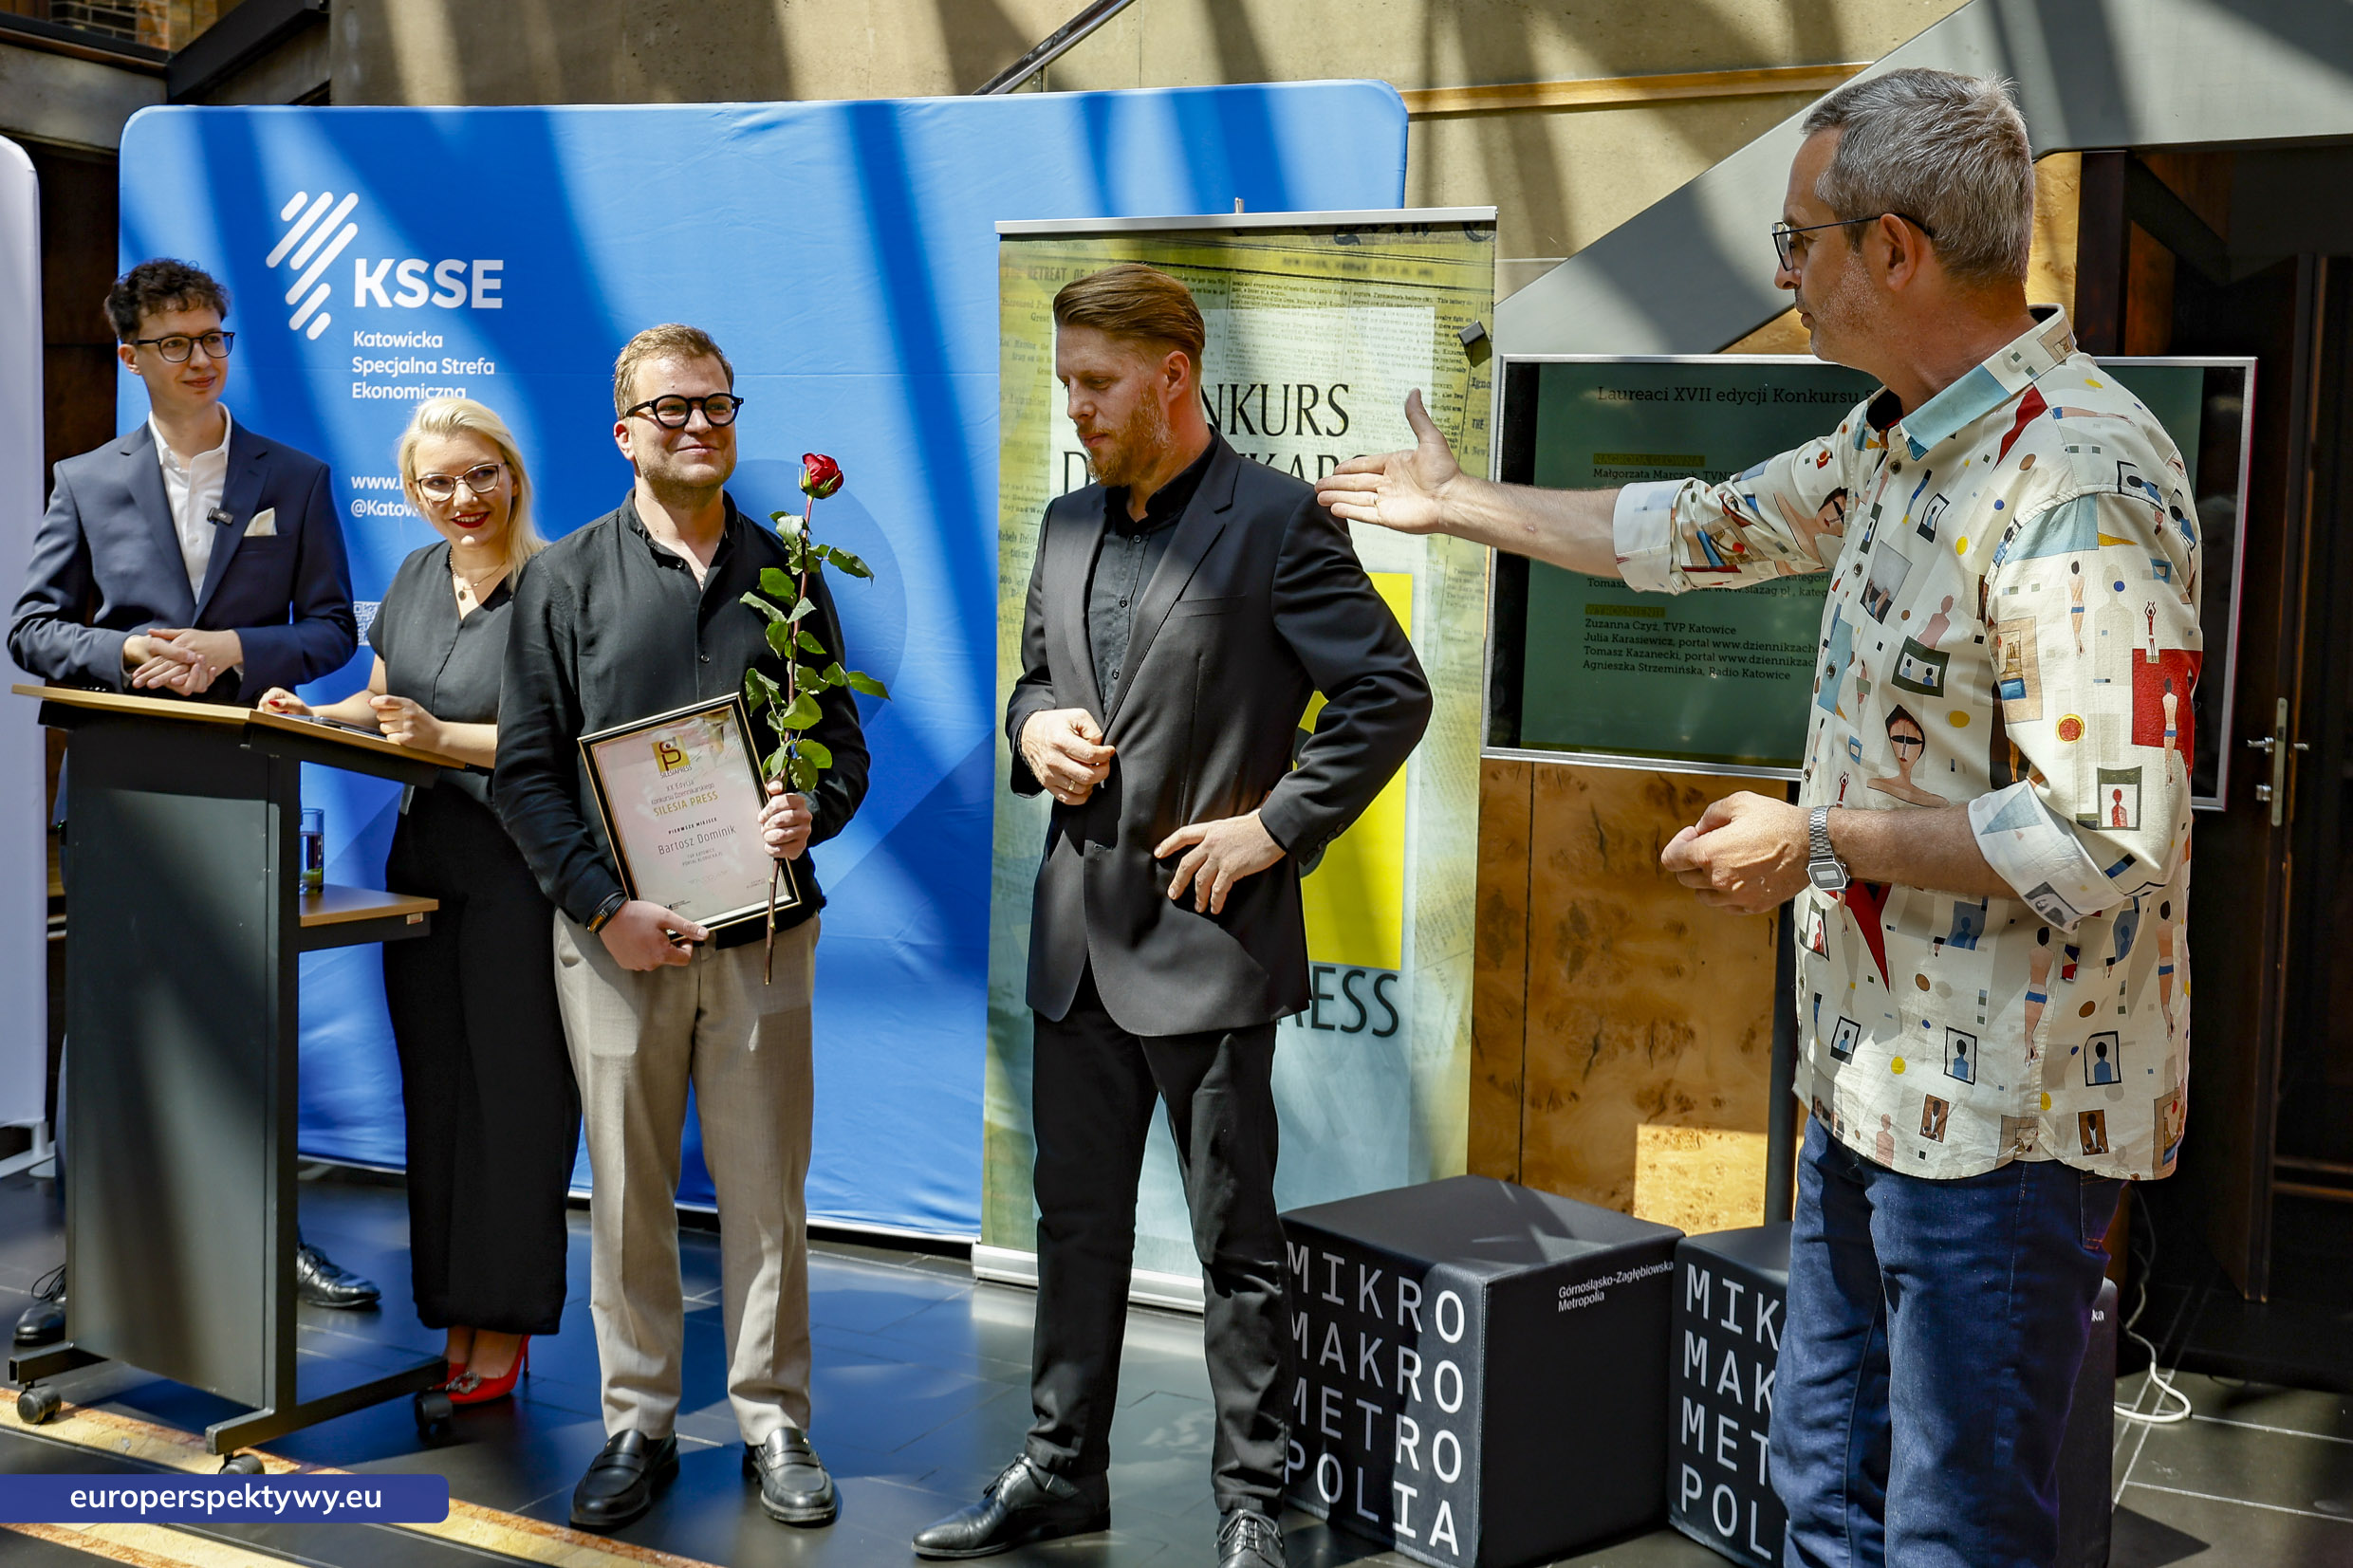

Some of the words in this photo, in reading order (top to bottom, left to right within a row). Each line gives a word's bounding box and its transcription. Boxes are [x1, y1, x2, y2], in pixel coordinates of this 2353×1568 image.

[353, 257, 504, 309] KSSE
[353, 330, 443, 349] Katowicka
[351, 356, 437, 378] Specjalna
[441, 357, 495, 376] Strefa
[351, 381, 468, 400] Ekonomiczna
[1597, 386, 1669, 402] Laureaci
[1673, 387, 1712, 403] XVII
[1715, 387, 1767, 407] edycji
[1772, 388, 1859, 405] Konkursu
[1200, 383, 1349, 437] NKURS
[1593, 468, 1650, 480] Małgorzata
[1587, 578, 1627, 588] Tomasz
[1799, 586, 1827, 600] kateg
[1584, 618, 1630, 630] Zuzanna
[1663, 622, 1686, 633] TVP
[1688, 624, 1736, 636] Katowice
[1584, 632, 1609, 643] Julia
[1611, 634, 1676, 647] Karasiewicz,
[1678, 637, 1710, 649] portal
[1584, 645, 1623, 657] Tomasz
[1626, 647, 1681, 660] Kazanecki,
[1684, 650, 1715, 662] portal
[1583, 659, 1636, 672] Agnieszka
[1638, 662, 1705, 676] Strzemińska,
[1709, 666, 1739, 677] Radio
[1742, 669, 1791, 680] Katowice
[653, 799, 688, 817] SILESIA
[690, 790, 719, 807] PRESS
[658, 837, 695, 856] Bartosz
[696, 824, 737, 844] Dominik
[1286, 1241, 1465, 1345] MIKRO
[1558, 1260, 1675, 1299] Górnośląsko-Zagłębiowska
[1558, 1289, 1605, 1313] Metropolia
[1686, 1262, 1781, 1352] MIK
[1290, 1310, 1464, 1414] MAKRO
[1683, 1329, 1776, 1414] MAK
[1680, 1395, 1770, 1487] MET
[1284, 1439, 1459, 1557] POLIA
[1680, 1462, 1772, 1561] POL
